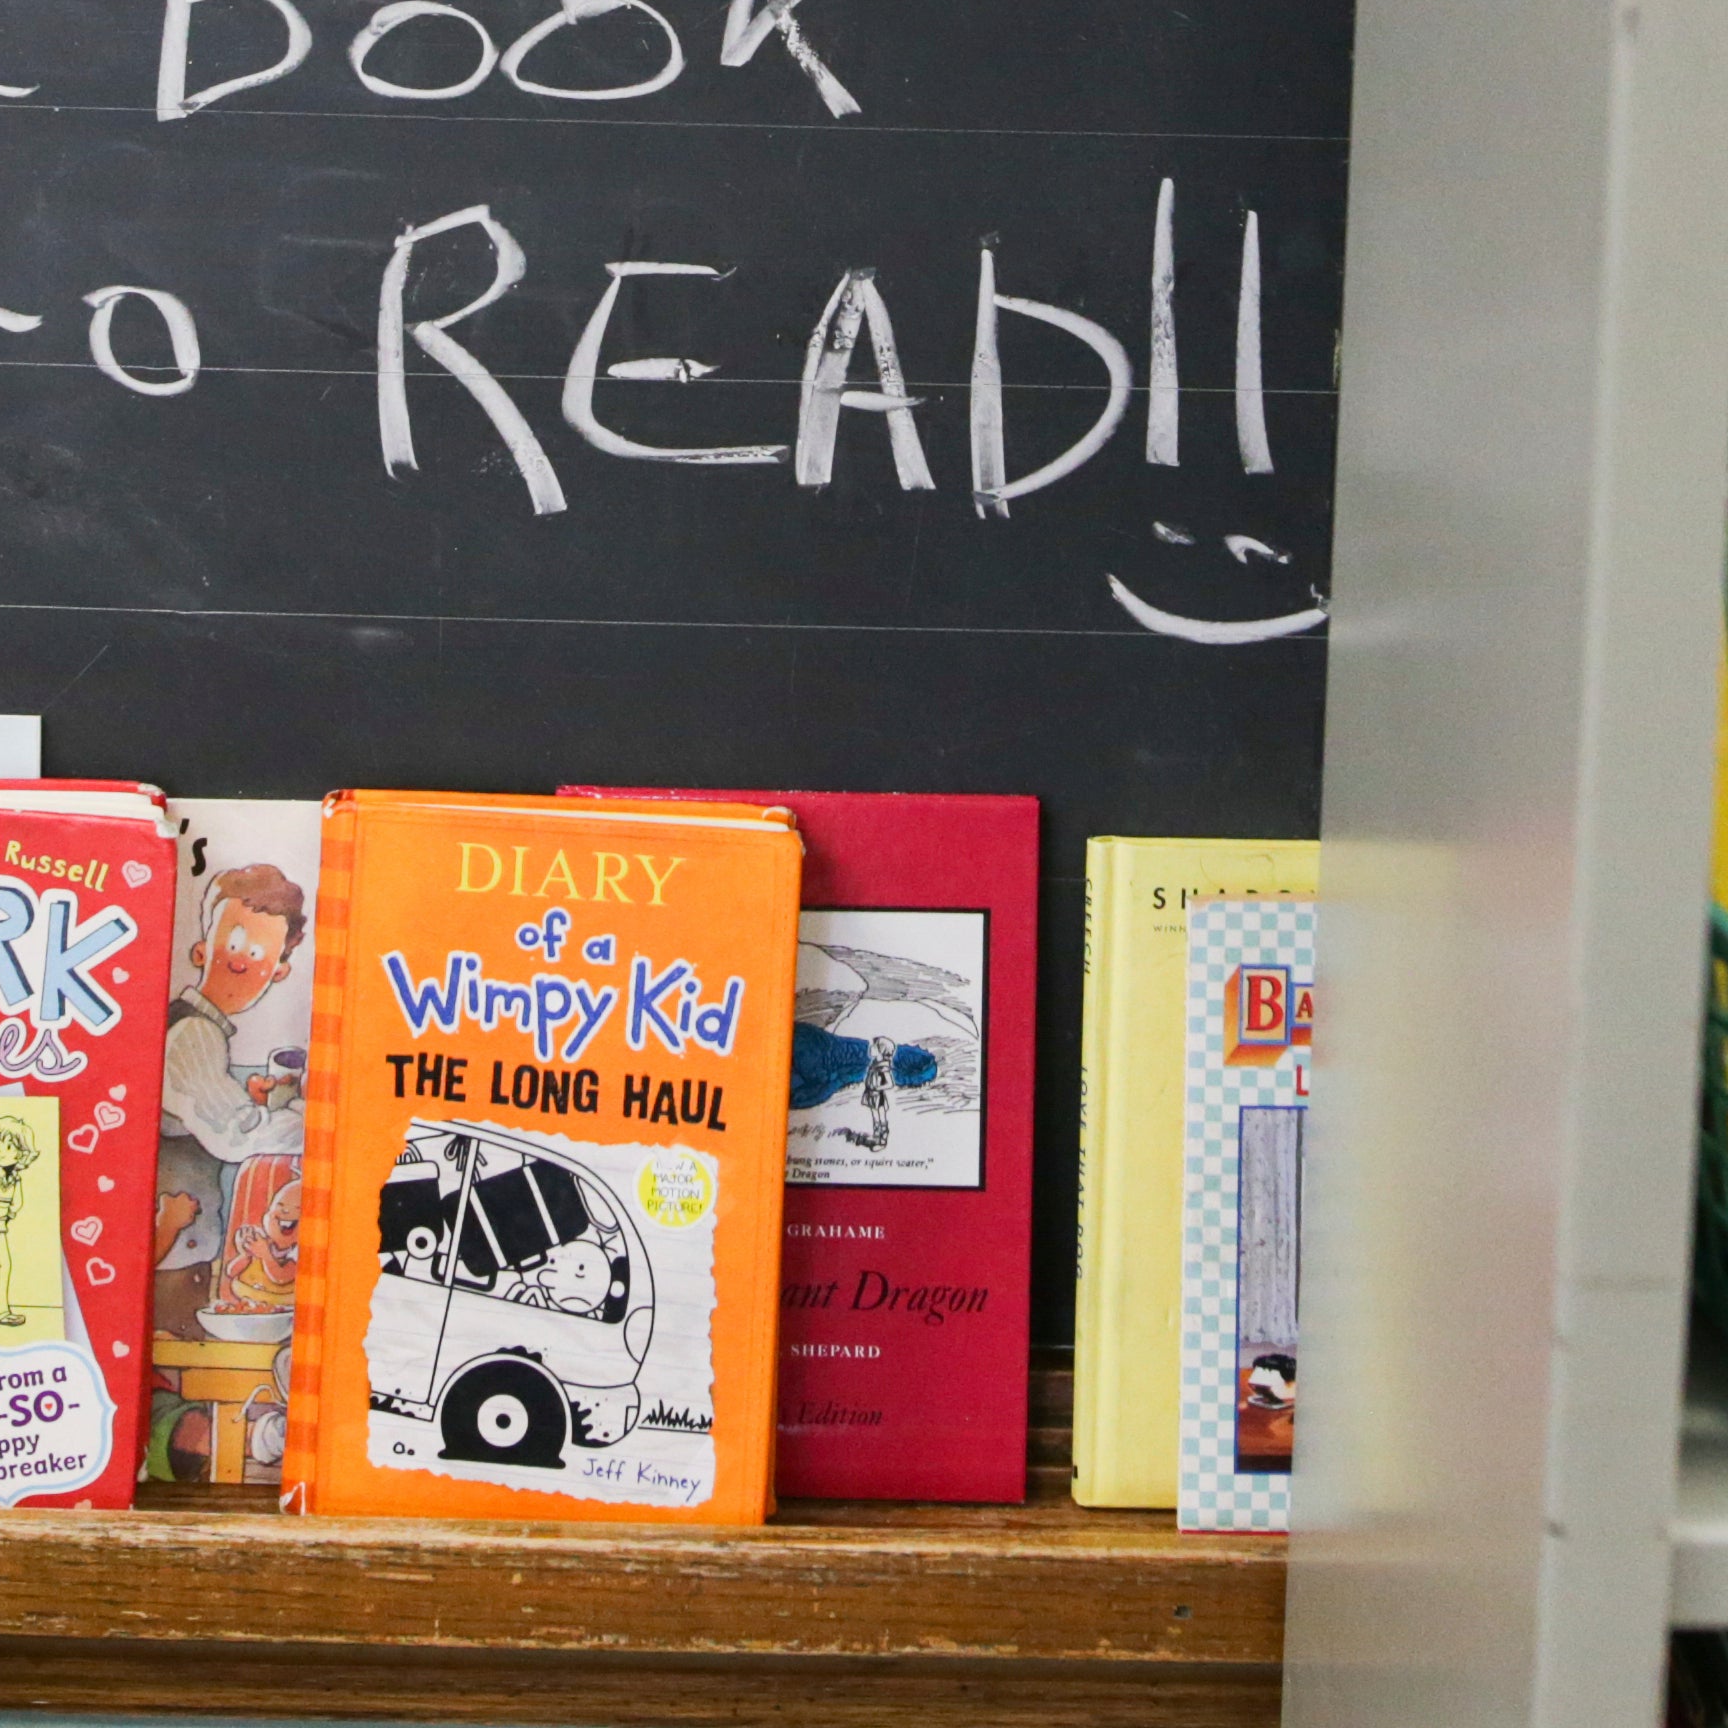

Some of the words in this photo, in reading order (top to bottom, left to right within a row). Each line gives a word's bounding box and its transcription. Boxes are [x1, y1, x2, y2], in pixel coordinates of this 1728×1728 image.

[5, 840, 109, 892] Russell
[455, 842, 686, 906] DIARY
[519, 910, 567, 958] of
[586, 938, 612, 960] a
[387, 956, 613, 1058] Wimpy
[631, 962, 740, 1049] Kid
[386, 1052, 468, 1102] THE
[491, 1061, 599, 1115] LONG
[623, 1074, 727, 1132] HAUL
[851, 1158, 862, 1166] or
[653, 1174, 694, 1184] MAJOR
[792, 1169, 830, 1181] Dragon
[651, 1187, 700, 1199] MOTION
[647, 1200, 703, 1214] PICTURE!
[787, 1224, 886, 1239] GRAHAME
[849, 1270, 990, 1326] Dragon
[791, 1344, 882, 1359] SHEPARD
[53, 1366, 67, 1383] a
[797, 1404, 883, 1426] Edition
[582, 1458, 626, 1482] Jeff
[637, 1461, 701, 1502] Kinney
